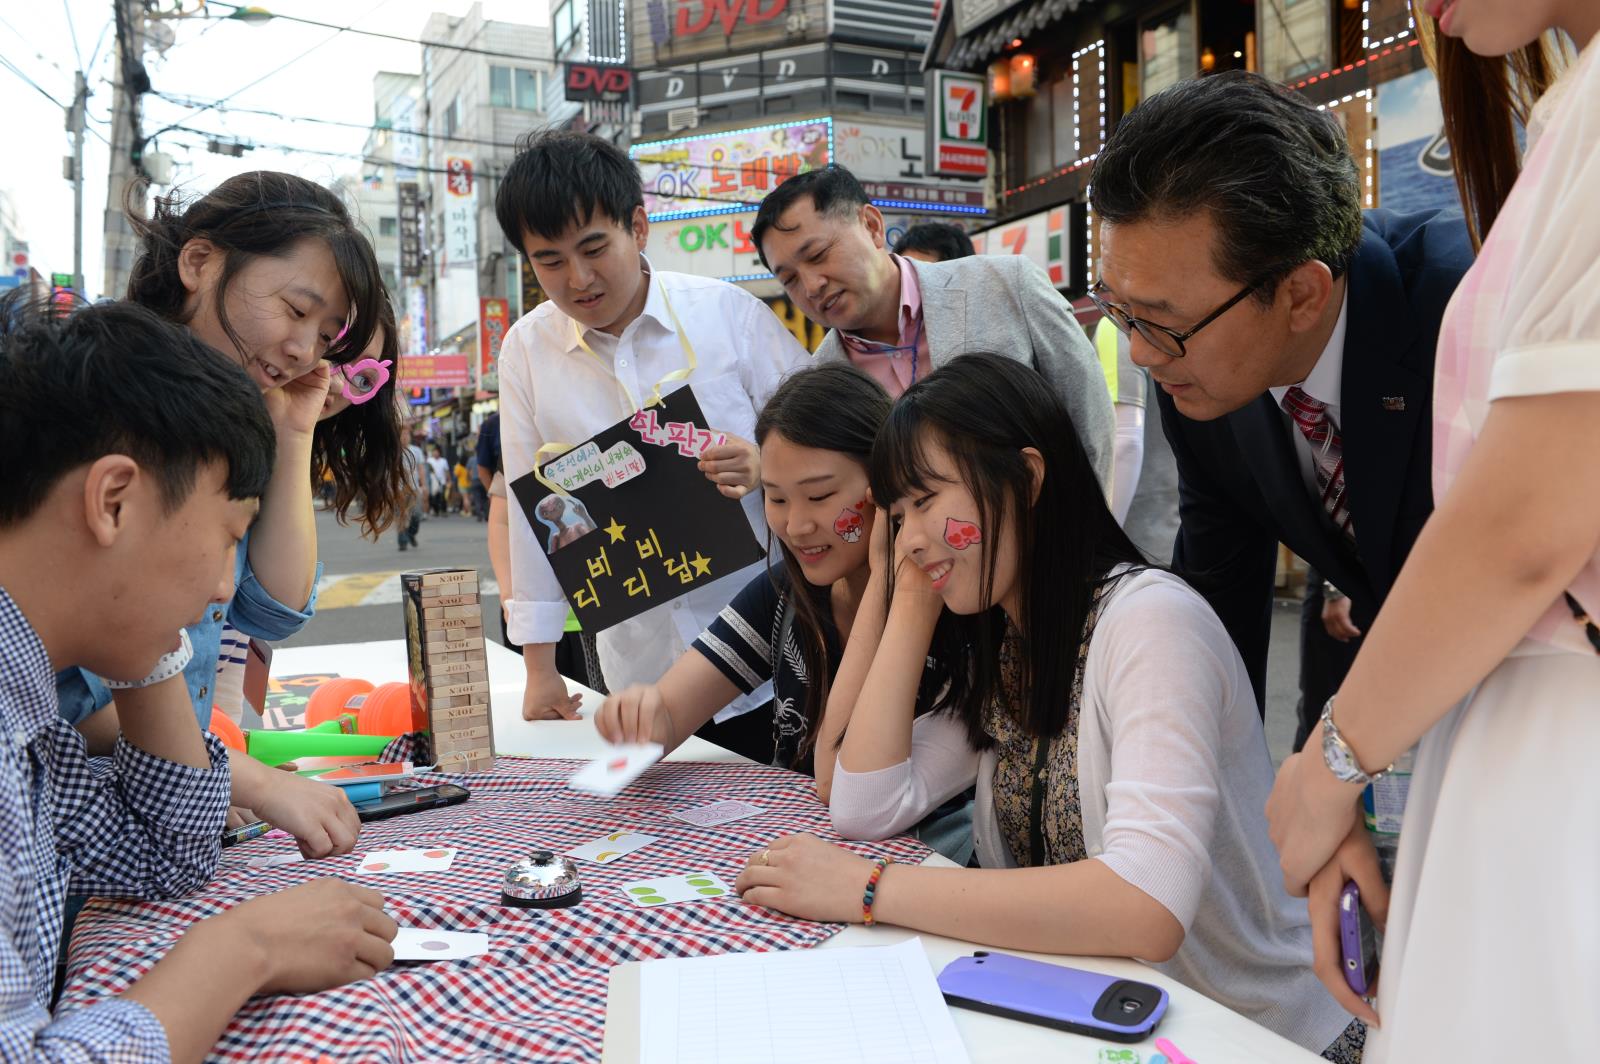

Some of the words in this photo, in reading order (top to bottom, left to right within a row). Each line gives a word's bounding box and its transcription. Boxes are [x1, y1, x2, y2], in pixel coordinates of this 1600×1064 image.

[672, 0, 789, 38] DVD
[568, 66, 631, 94] DVD
[657, 168, 699, 197] OK
[678, 222, 729, 252] OK
